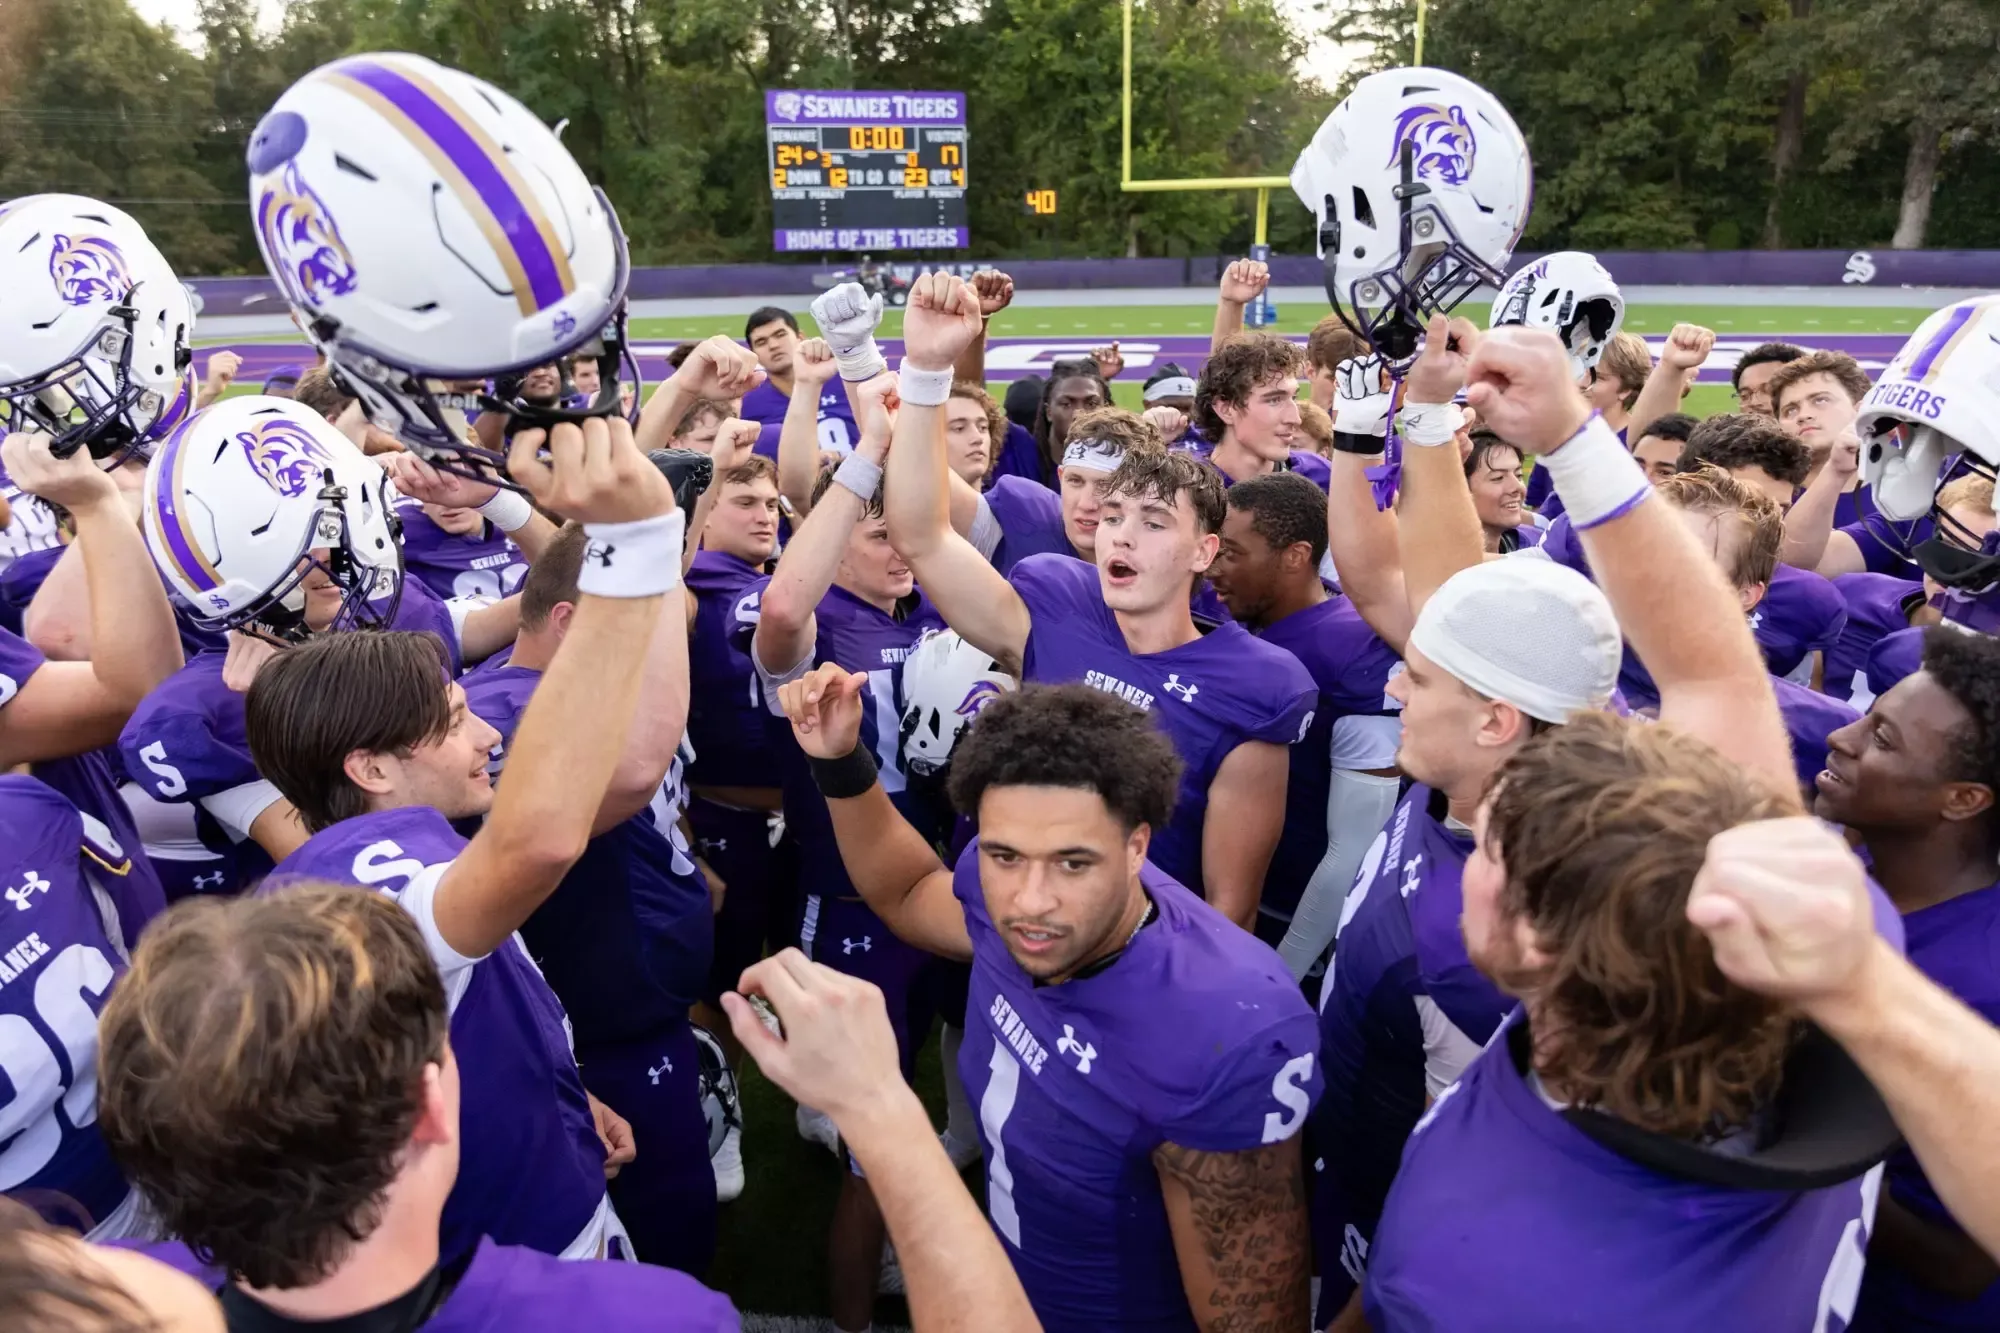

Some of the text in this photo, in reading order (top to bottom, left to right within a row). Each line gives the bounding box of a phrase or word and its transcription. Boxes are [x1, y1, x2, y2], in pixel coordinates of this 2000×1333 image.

[803, 95, 958, 119] SEWANEE TIGERS
[849, 126, 904, 151] 0:00
[777, 144, 803, 166] 24
[774, 168, 787, 189] 2
[787, 169, 821, 185] DOWN
[829, 168, 848, 189] 12
[848, 169, 864, 185] TO
[866, 169, 884, 185] GO
[904, 168, 928, 189] 23
[951, 168, 965, 188] 4
[1026, 190, 1056, 213] 40
[786, 228, 958, 249] HOME OF THE TIGERS
[1870, 383, 1946, 419] TIGERS
[470, 552, 511, 570] SEWANEE
[881, 648, 910, 664] SEWA
[1084, 669, 1155, 712] SEWANEE
[139, 740, 188, 798] S
[351, 838, 425, 901] S
[0, 931, 51, 992] ANEE
[990, 993, 1049, 1076] SEWANEE
[1261, 1052, 1315, 1145] S
